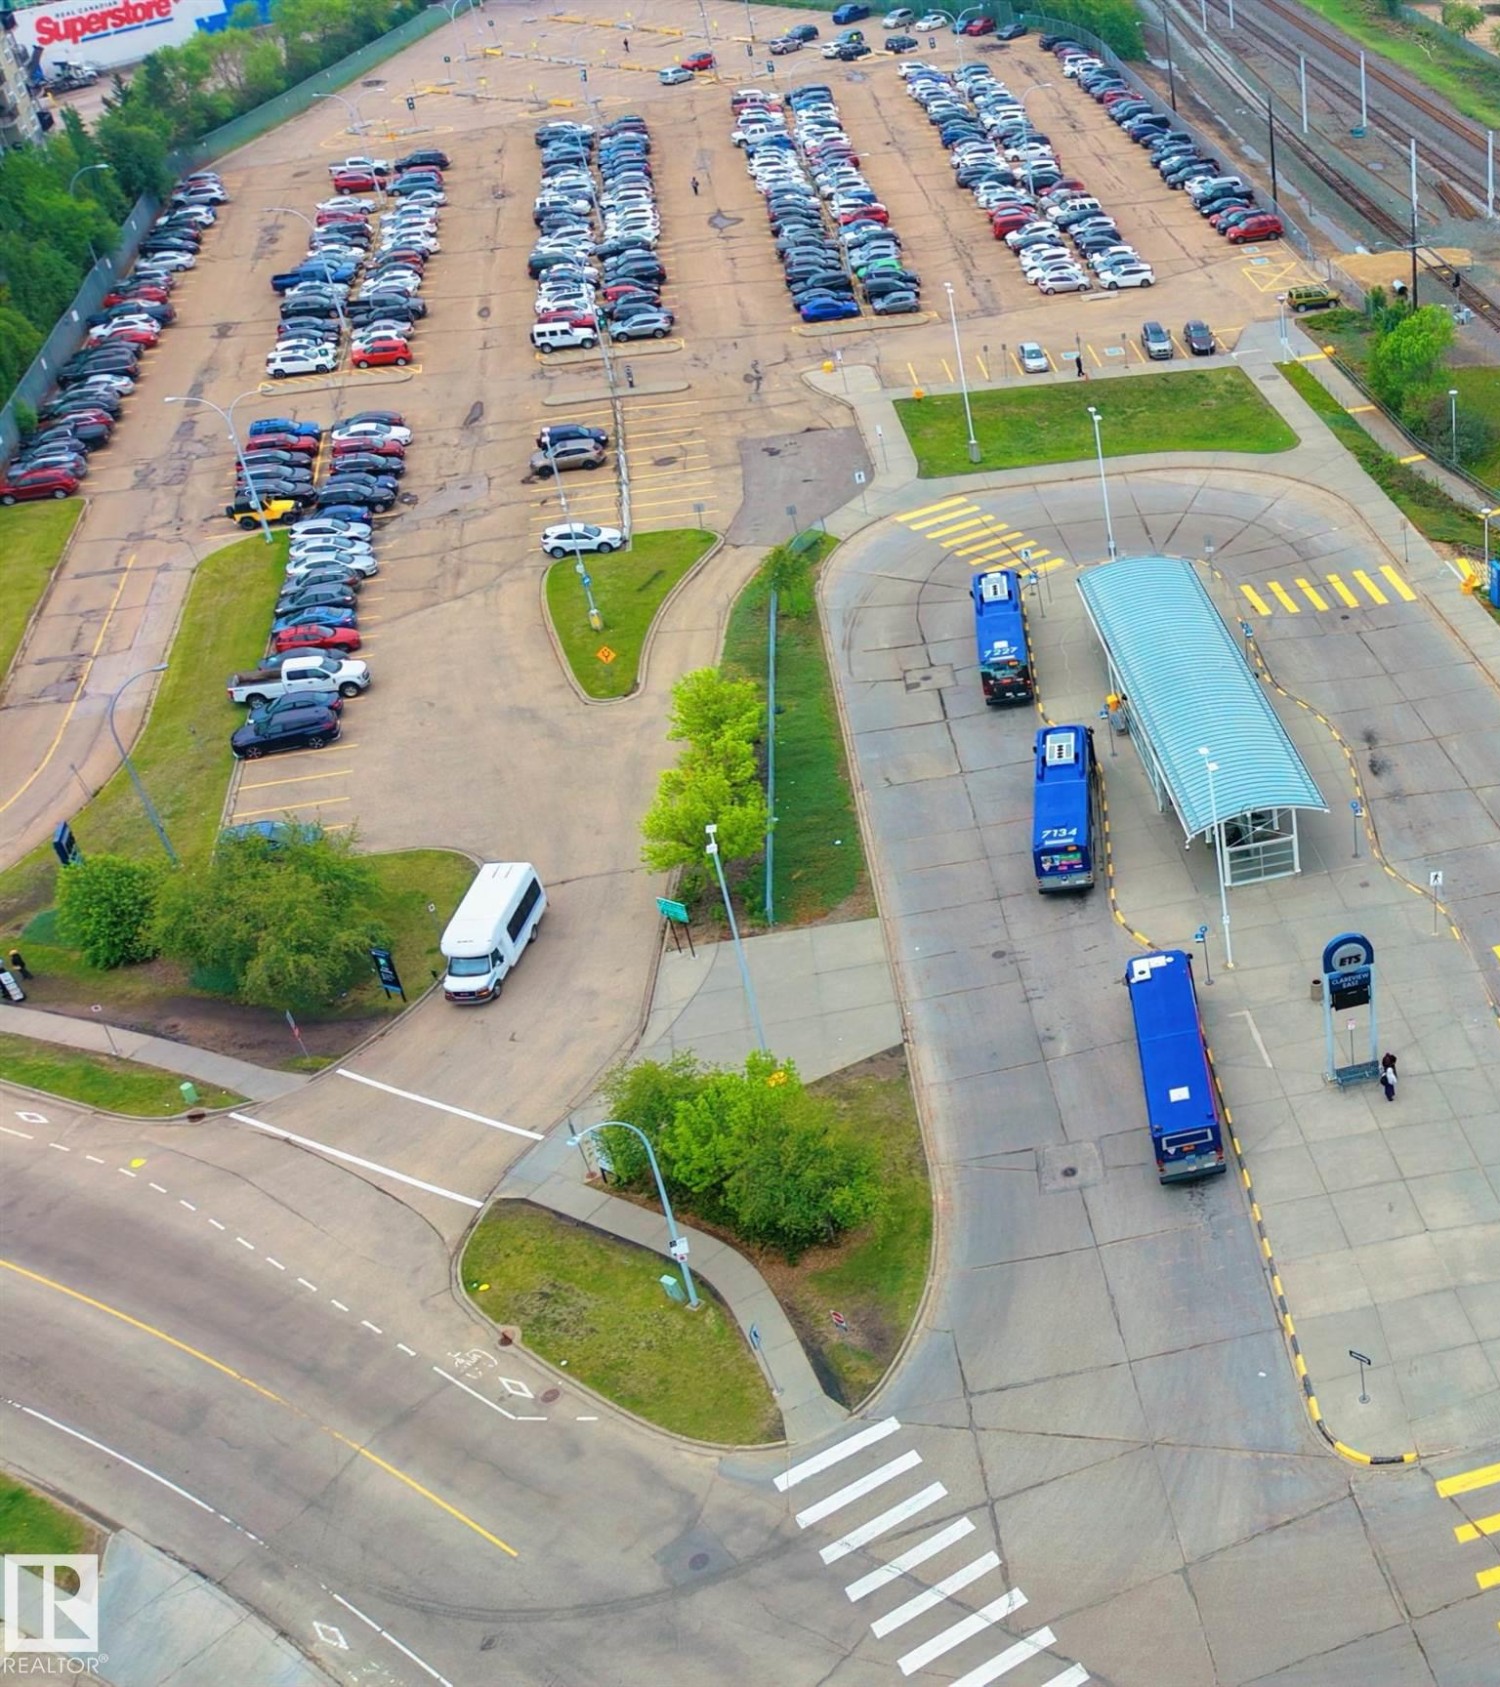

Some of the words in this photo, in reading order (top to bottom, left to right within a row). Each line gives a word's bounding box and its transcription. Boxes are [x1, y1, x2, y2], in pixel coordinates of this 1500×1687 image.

[35, 0, 172, 45] Superstore
[1041, 827, 1078, 839] 7134
[1339, 954, 1362, 967] ETS
[1331, 973, 1369, 986] CLAREVIEW
